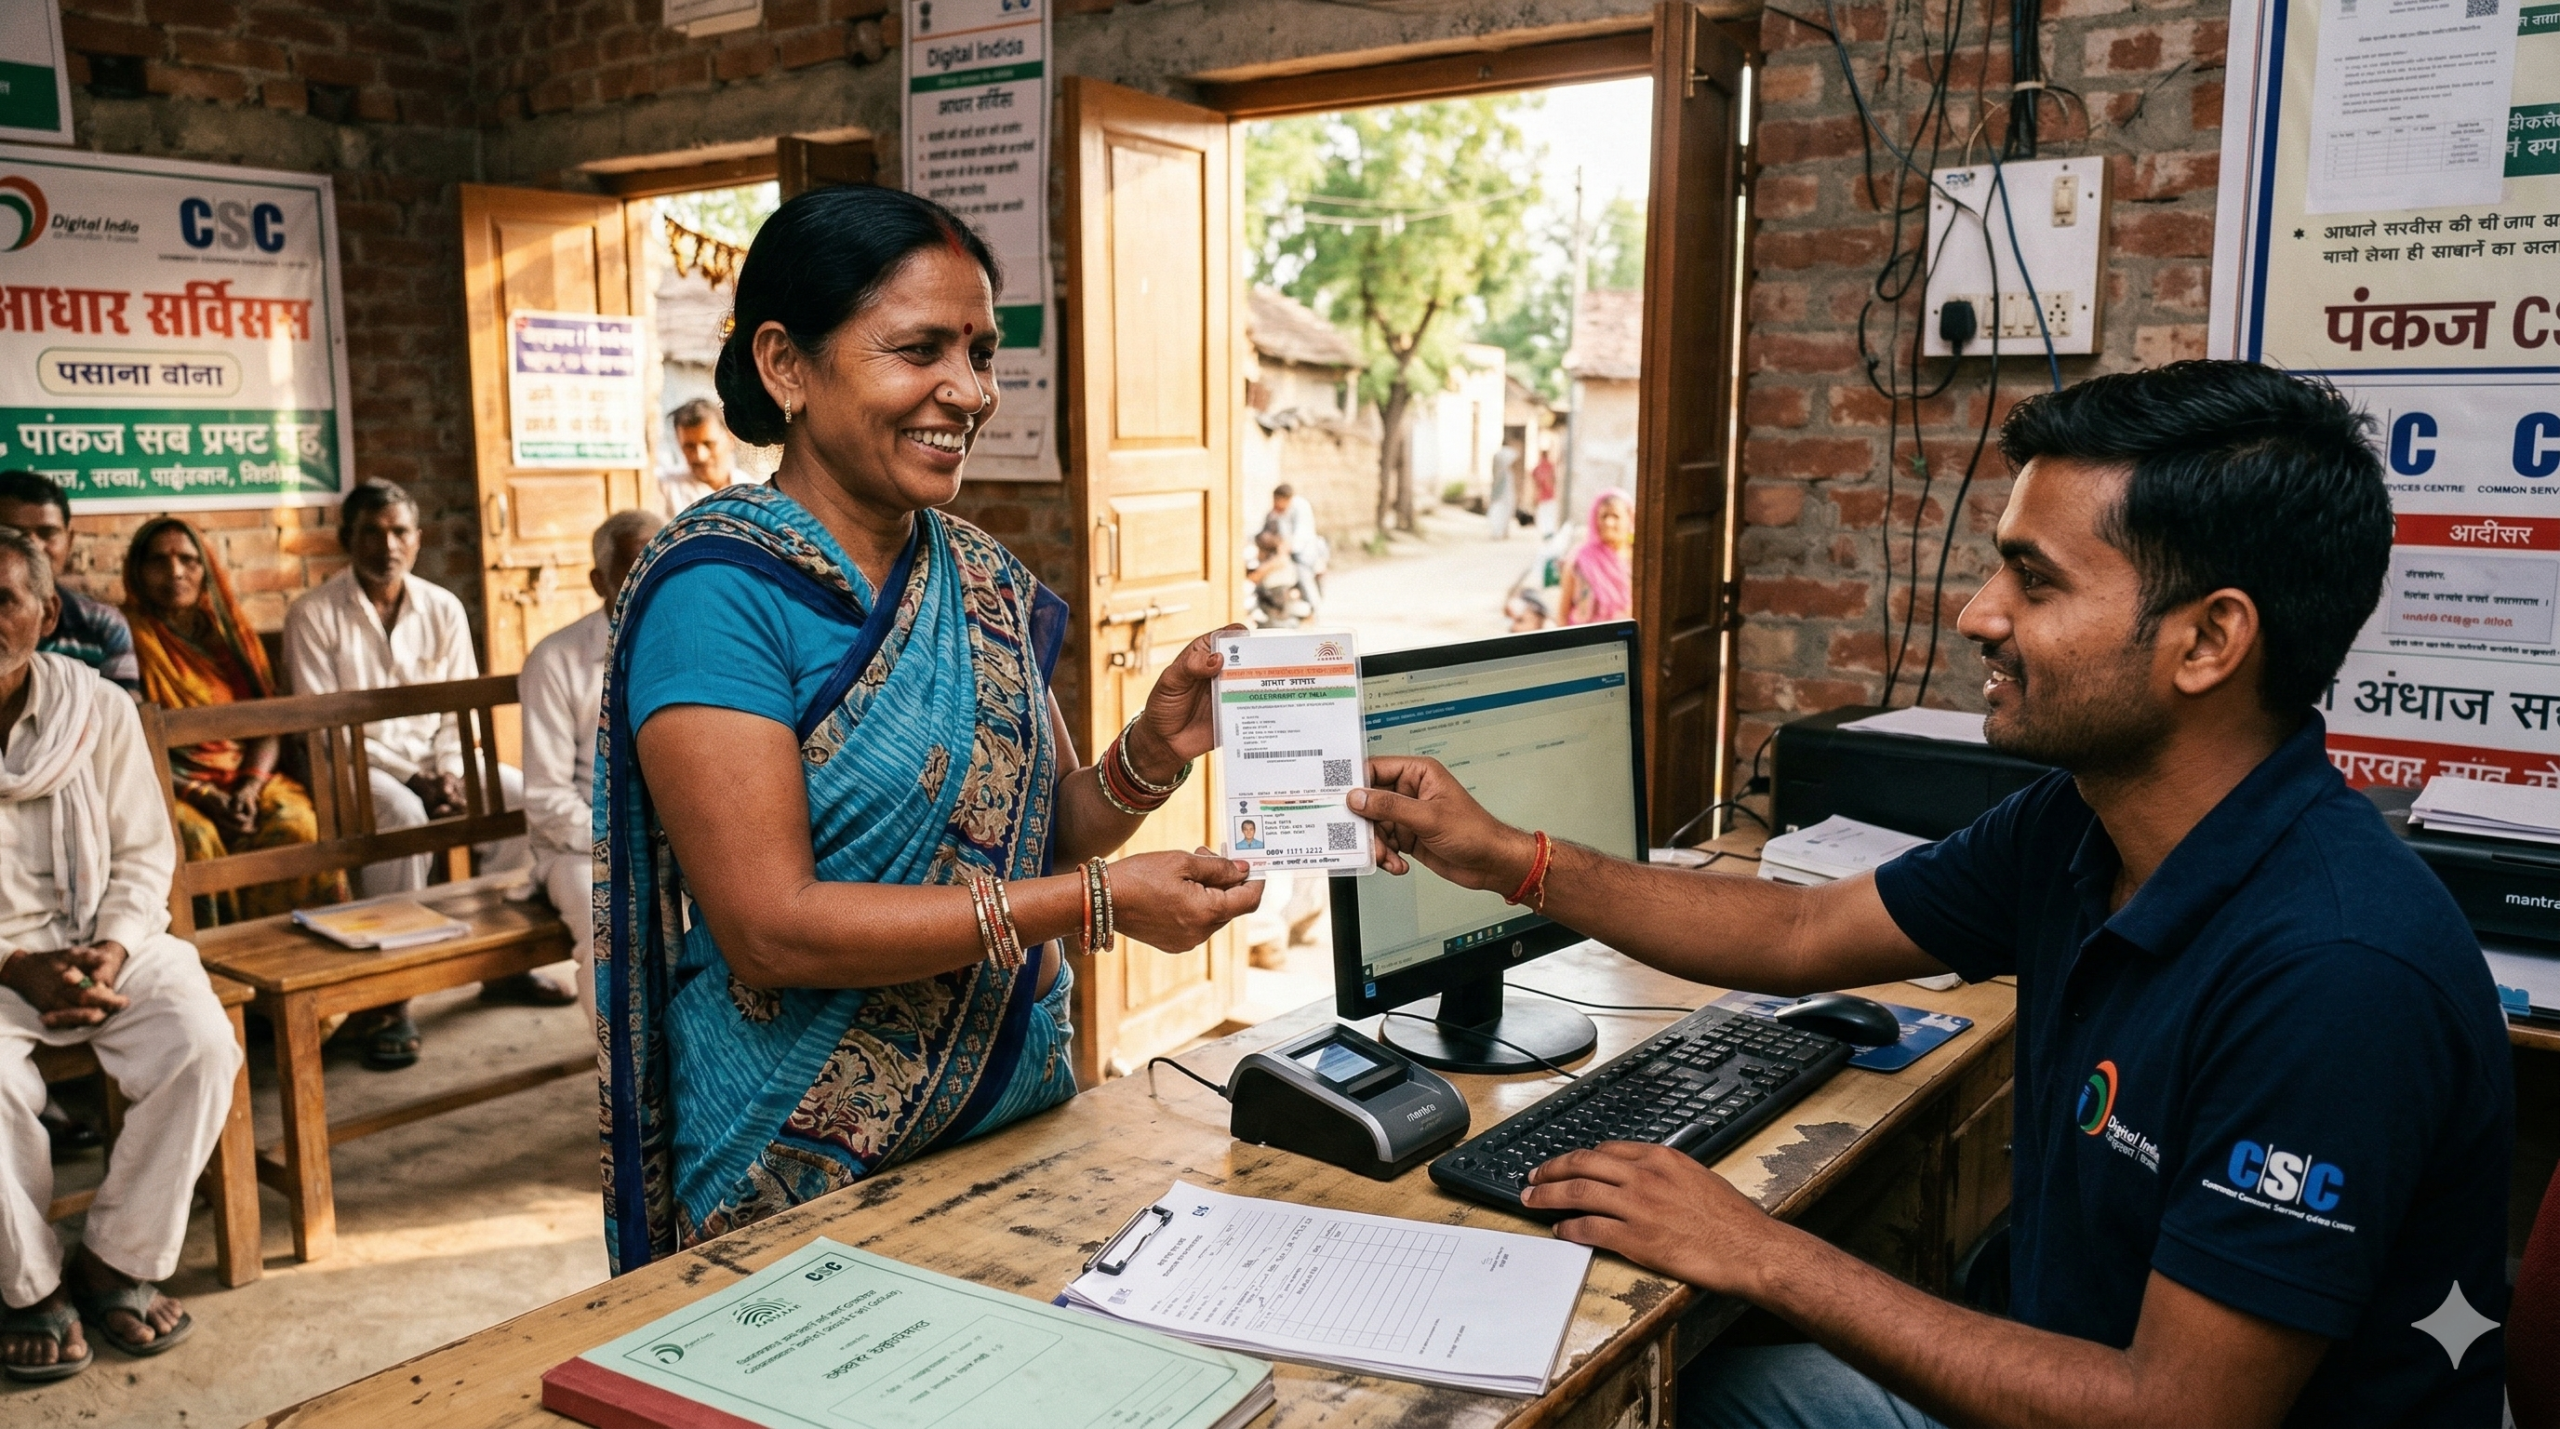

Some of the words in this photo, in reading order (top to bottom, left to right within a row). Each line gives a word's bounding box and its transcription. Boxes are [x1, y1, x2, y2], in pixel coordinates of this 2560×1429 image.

[51, 213, 102, 232] Digital
[104, 217, 140, 233] India
[2449, 214, 2472, 232] की
[2491, 242, 2516, 257] का
[2324, 286, 2496, 351] पंकज
[17, 413, 126, 455] पांकज
[2423, 484, 2466, 493] CENTRE
[2477, 485, 2527, 495] COMMON
[2354, 670, 2495, 725] अंधाज
[2505, 894, 2560, 910] mantra
[805, 1261, 843, 1282] CSC
